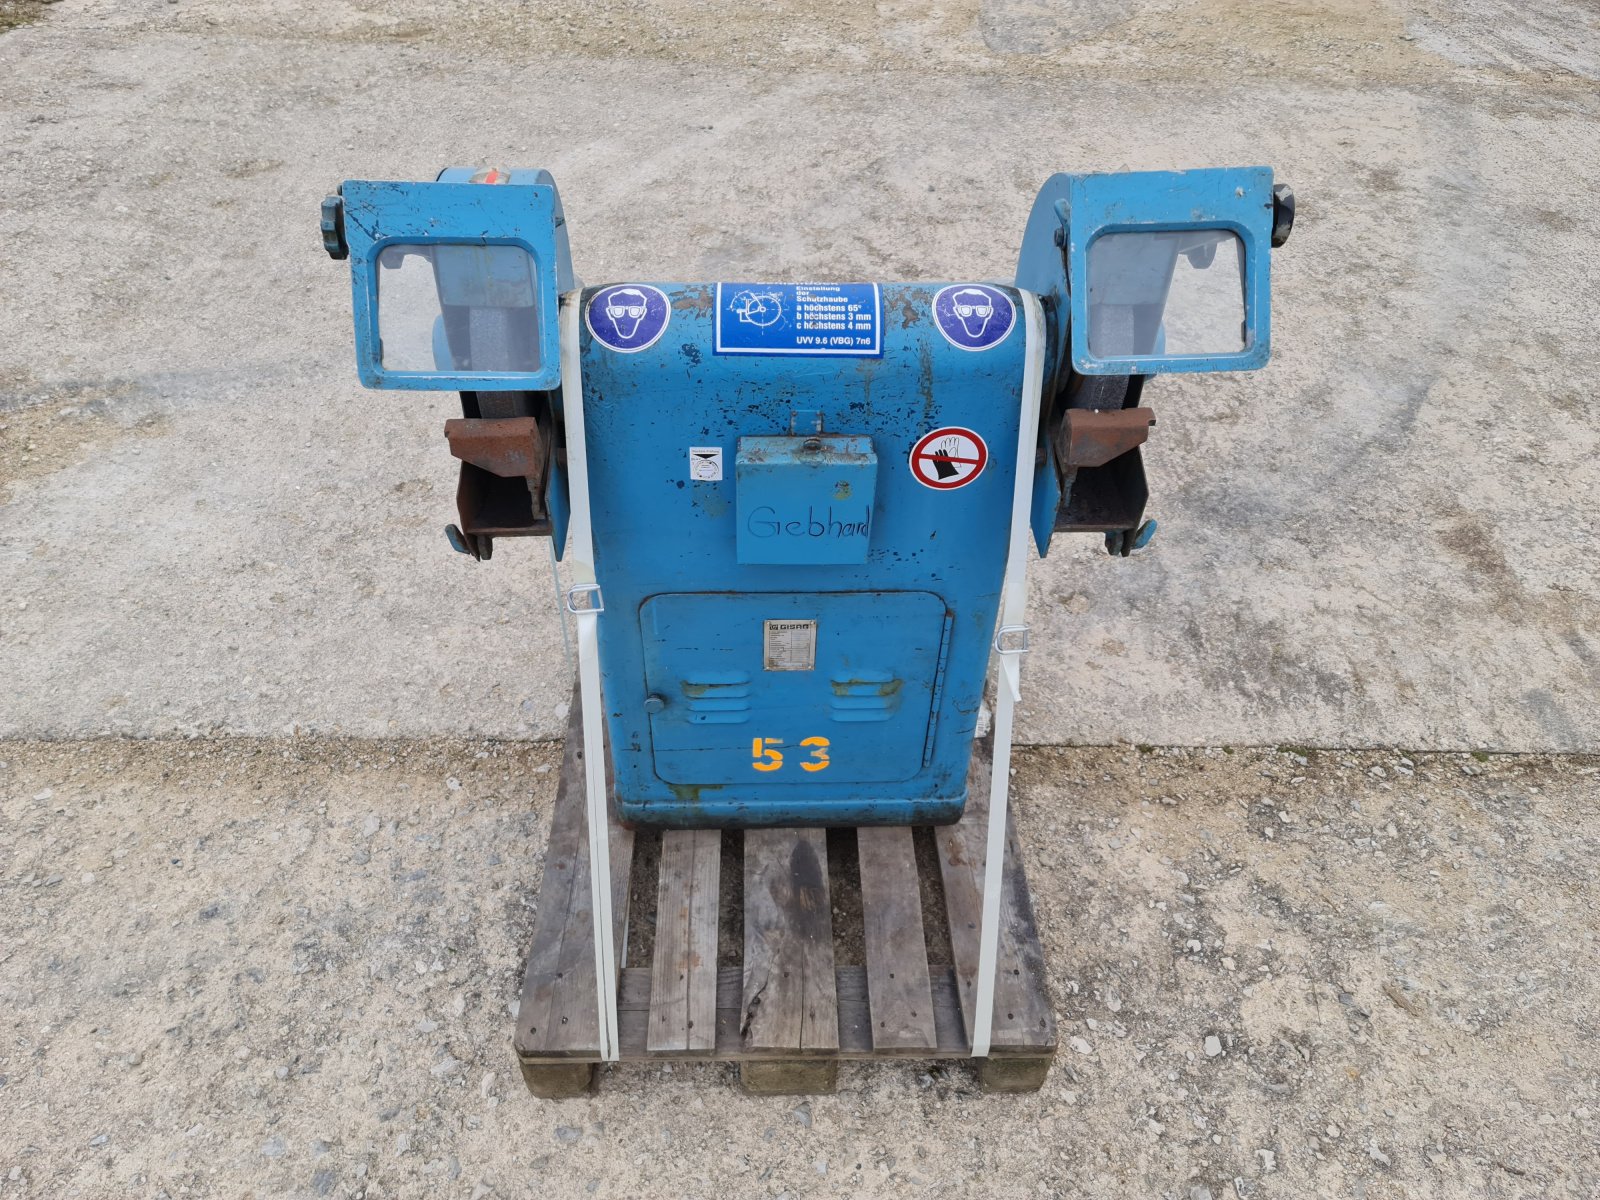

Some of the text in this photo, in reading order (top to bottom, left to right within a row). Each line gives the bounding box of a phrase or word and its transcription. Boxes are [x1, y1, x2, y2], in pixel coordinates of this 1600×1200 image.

[796, 312, 802, 320] b
[804, 312, 845, 320] höchstens
[848, 312, 853, 320] 3
[804, 321, 845, 329] höchstens
[848, 322, 853, 330] 4
[830, 337, 853, 346] (VBG)
[856, 337, 871, 345] 7n6
[747, 504, 870, 538] Gebhard
